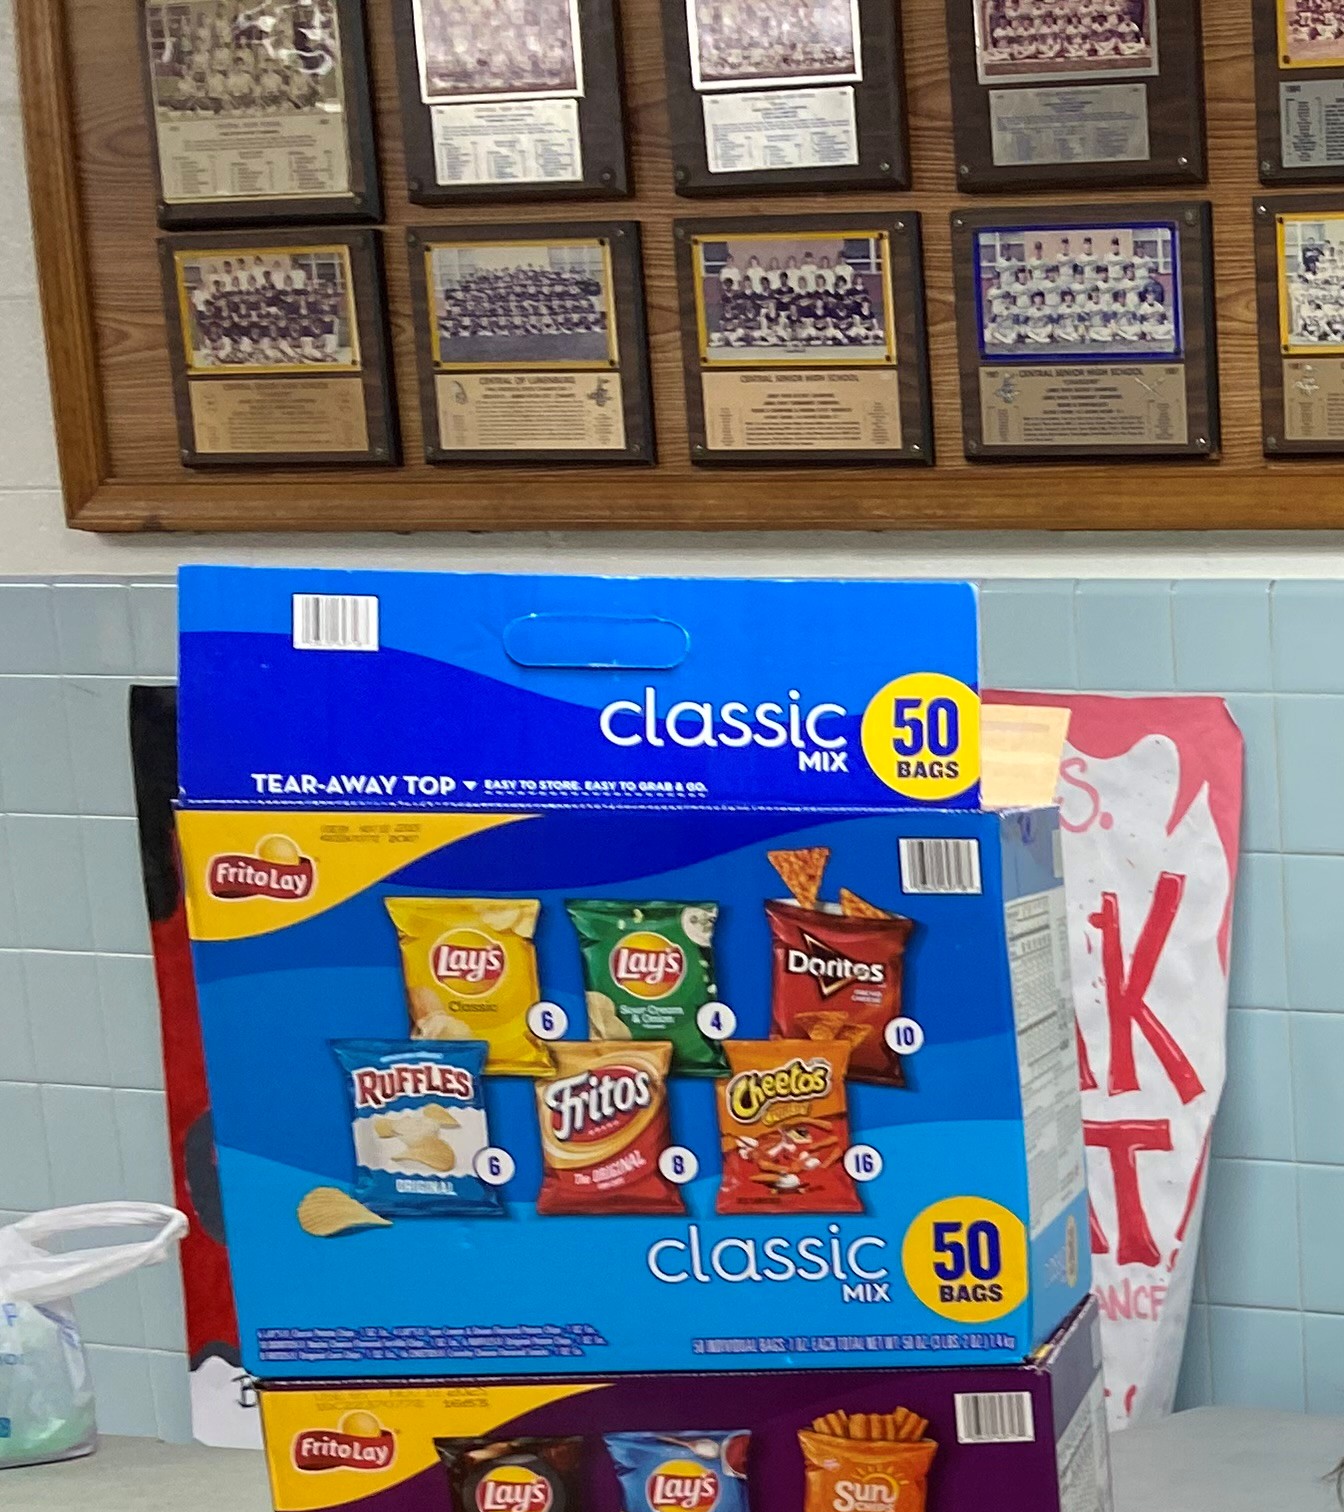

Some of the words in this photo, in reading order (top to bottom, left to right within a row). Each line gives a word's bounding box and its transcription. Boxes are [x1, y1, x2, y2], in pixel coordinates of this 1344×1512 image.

[600, 686, 848, 749] classic
[892, 698, 960, 758] 50
[798, 752, 848, 774] MIX
[896, 760, 960, 780] BAGS
[251, 773, 397, 795] TEAR-AWAY
[402, 775, 457, 797] TOP
[484, 779, 517, 791] EASY
[519, 779, 537, 791] TO
[584, 780, 616, 792] EASY
[618, 780, 636, 792] TO
[637, 781, 673, 792] GRAB
[437, 945, 501, 982] Lay's
[617, 948, 681, 984] Lay's
[787, 949, 885, 983] Doritos
[896, 1025, 914, 1047] 10
[355, 1064, 472, 1106] RUFFLES
[728, 1060, 830, 1122] Cheetos
[546, 1071, 650, 1142] Fritos
[854, 1153, 873, 1174] 16
[648, 1224, 888, 1283] classic
[932, 1219, 1001, 1282] 50
[842, 1283, 891, 1303] MIX
[939, 1284, 1004, 1303] BAGS
[654, 1476, 716, 1508] Lay's
[834, 1480, 898, 1512] Sun
